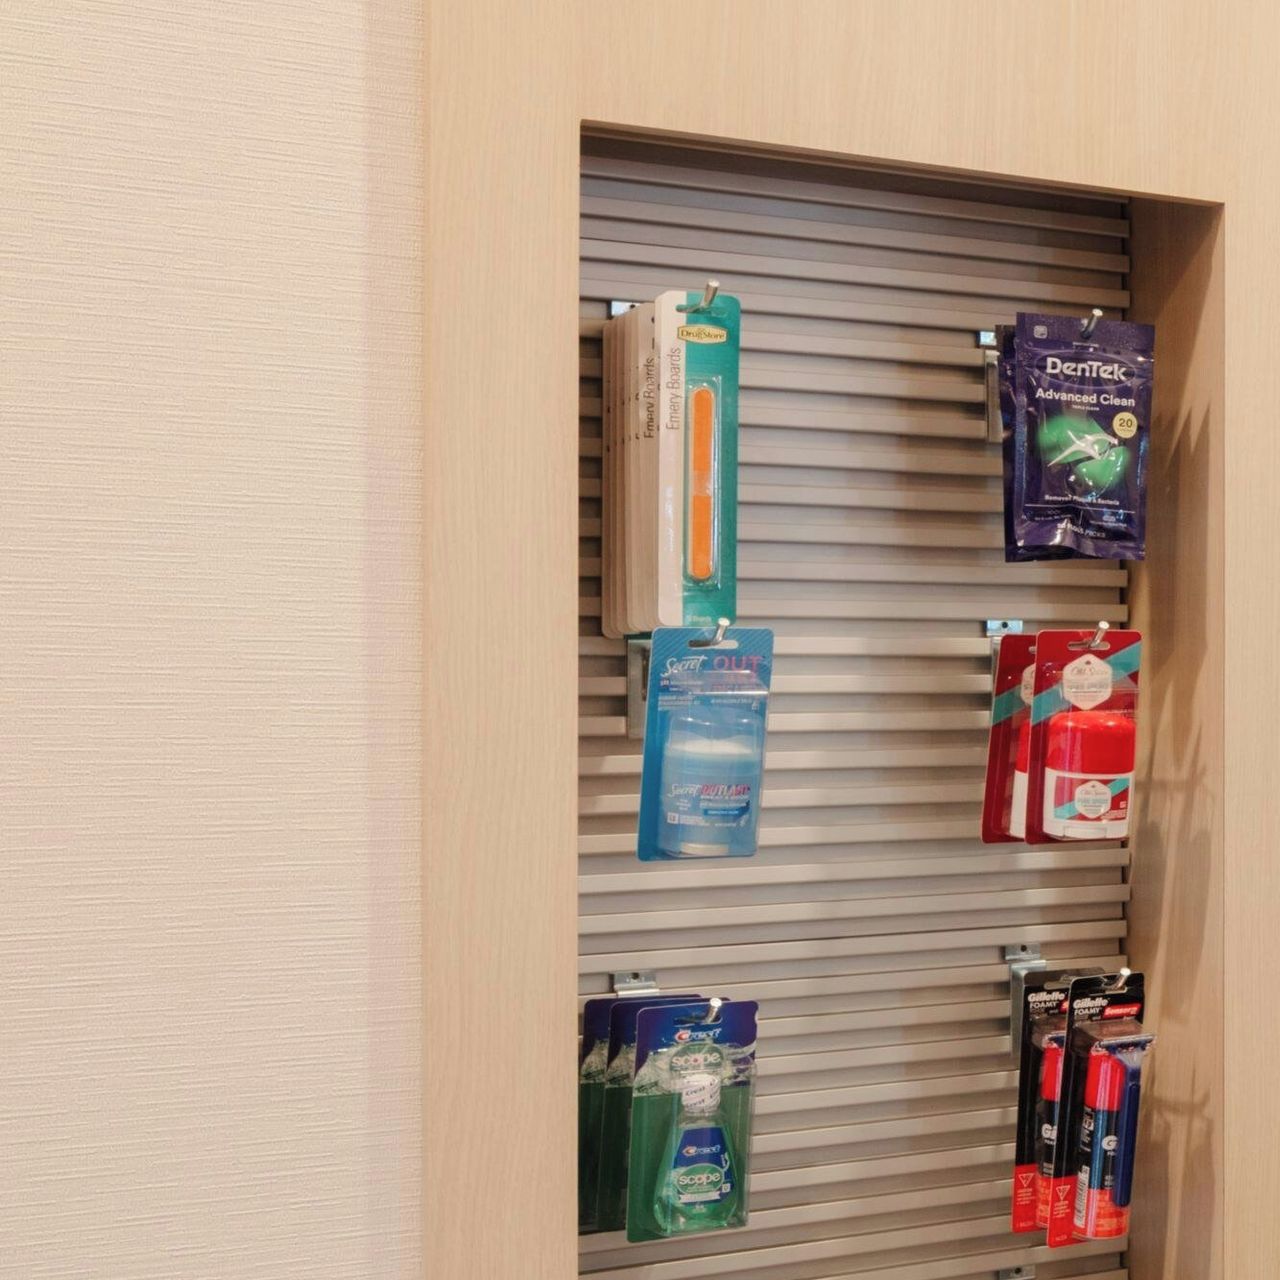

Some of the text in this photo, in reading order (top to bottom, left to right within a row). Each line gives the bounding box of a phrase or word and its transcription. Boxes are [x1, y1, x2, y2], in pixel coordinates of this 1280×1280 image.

[1046, 357, 1128, 381] DenTek
[665, 347, 682, 430] Emery Boards
[1035, 387, 1136, 407] Advanced Clean
[1118, 417, 1133, 427] 20
[660, 655, 708, 677] Secret
[1030, 1001, 1057, 1009] FOAMY
[1074, 1007, 1100, 1016] FOAMY
[672, 1053, 720, 1070] scope
[680, 1173, 720, 1185] scope
